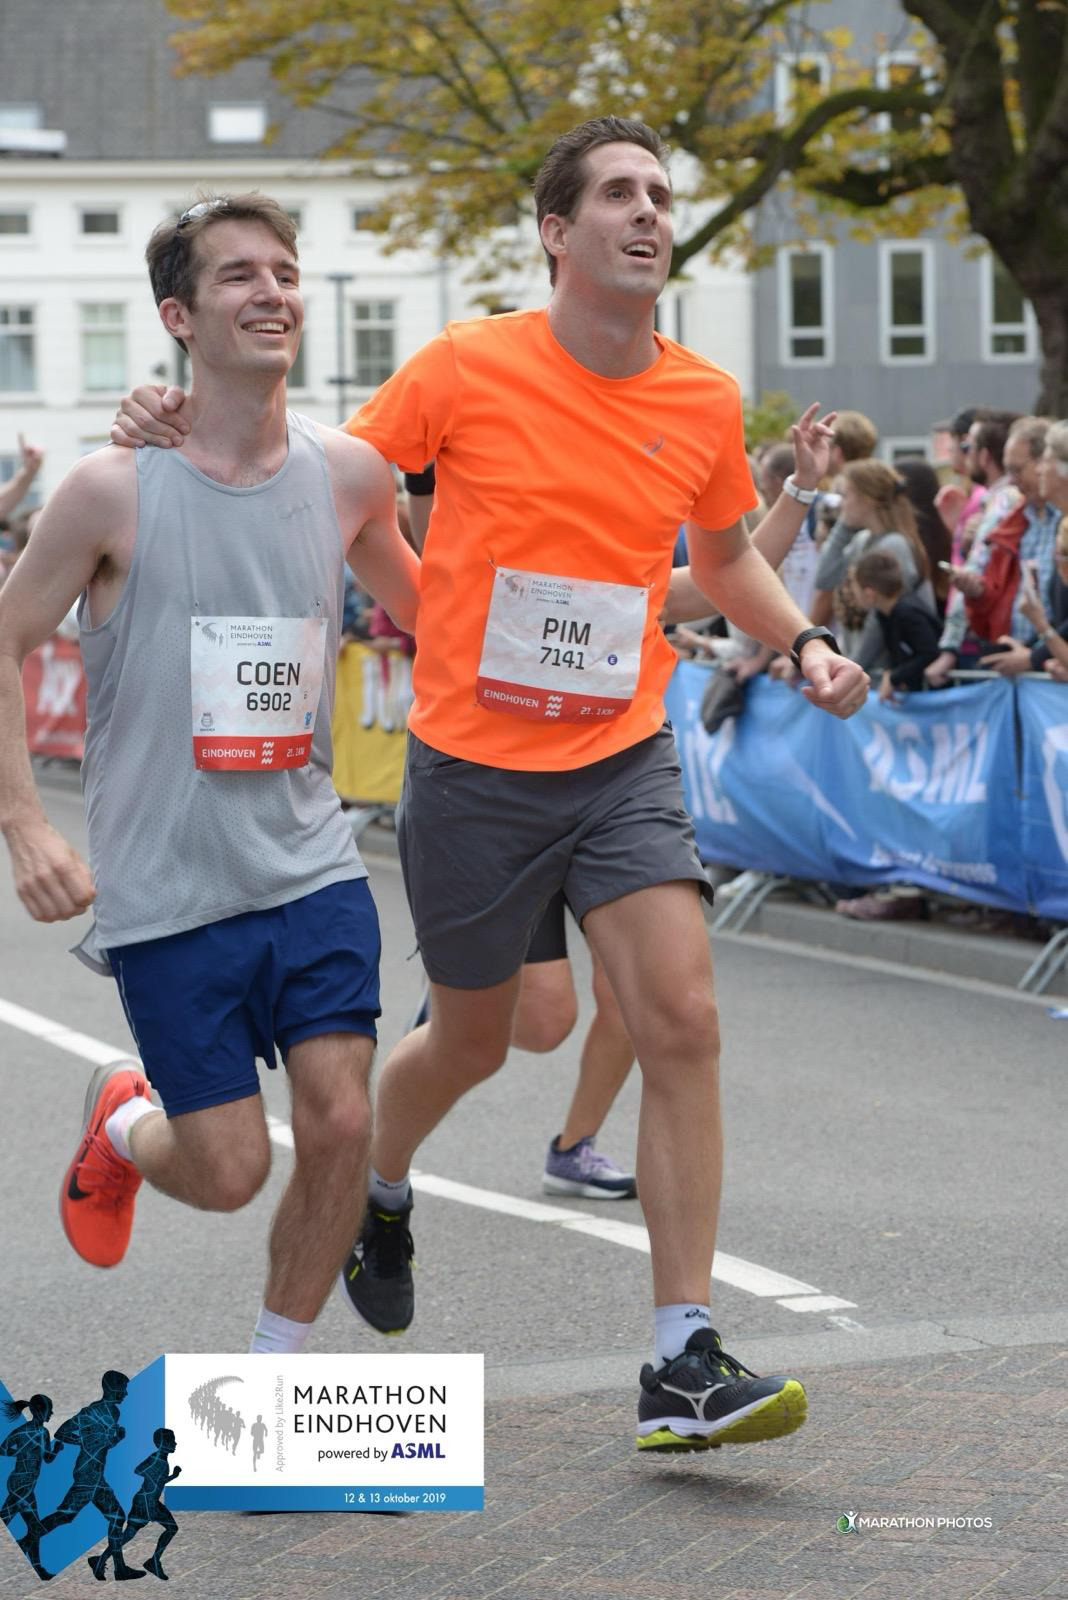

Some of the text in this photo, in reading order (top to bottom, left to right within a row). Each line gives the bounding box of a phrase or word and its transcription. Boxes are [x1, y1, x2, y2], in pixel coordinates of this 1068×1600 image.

[530, 587, 572, 599] EINDHOVEN
[532, 580, 574, 592] MARATHON
[230, 624, 273, 632] MARATHON
[230, 632, 273, 640] EINDHOVEN
[542, 617, 592, 646] PIM
[539, 646, 585, 671] 7141
[236, 661, 301, 686] COEN
[246, 692, 292, 712] 6902
[483, 689, 540, 709] EINDHOVEN
[202, 748, 256, 758] EINDHOVEN
[864, 722, 988, 804] ASML
